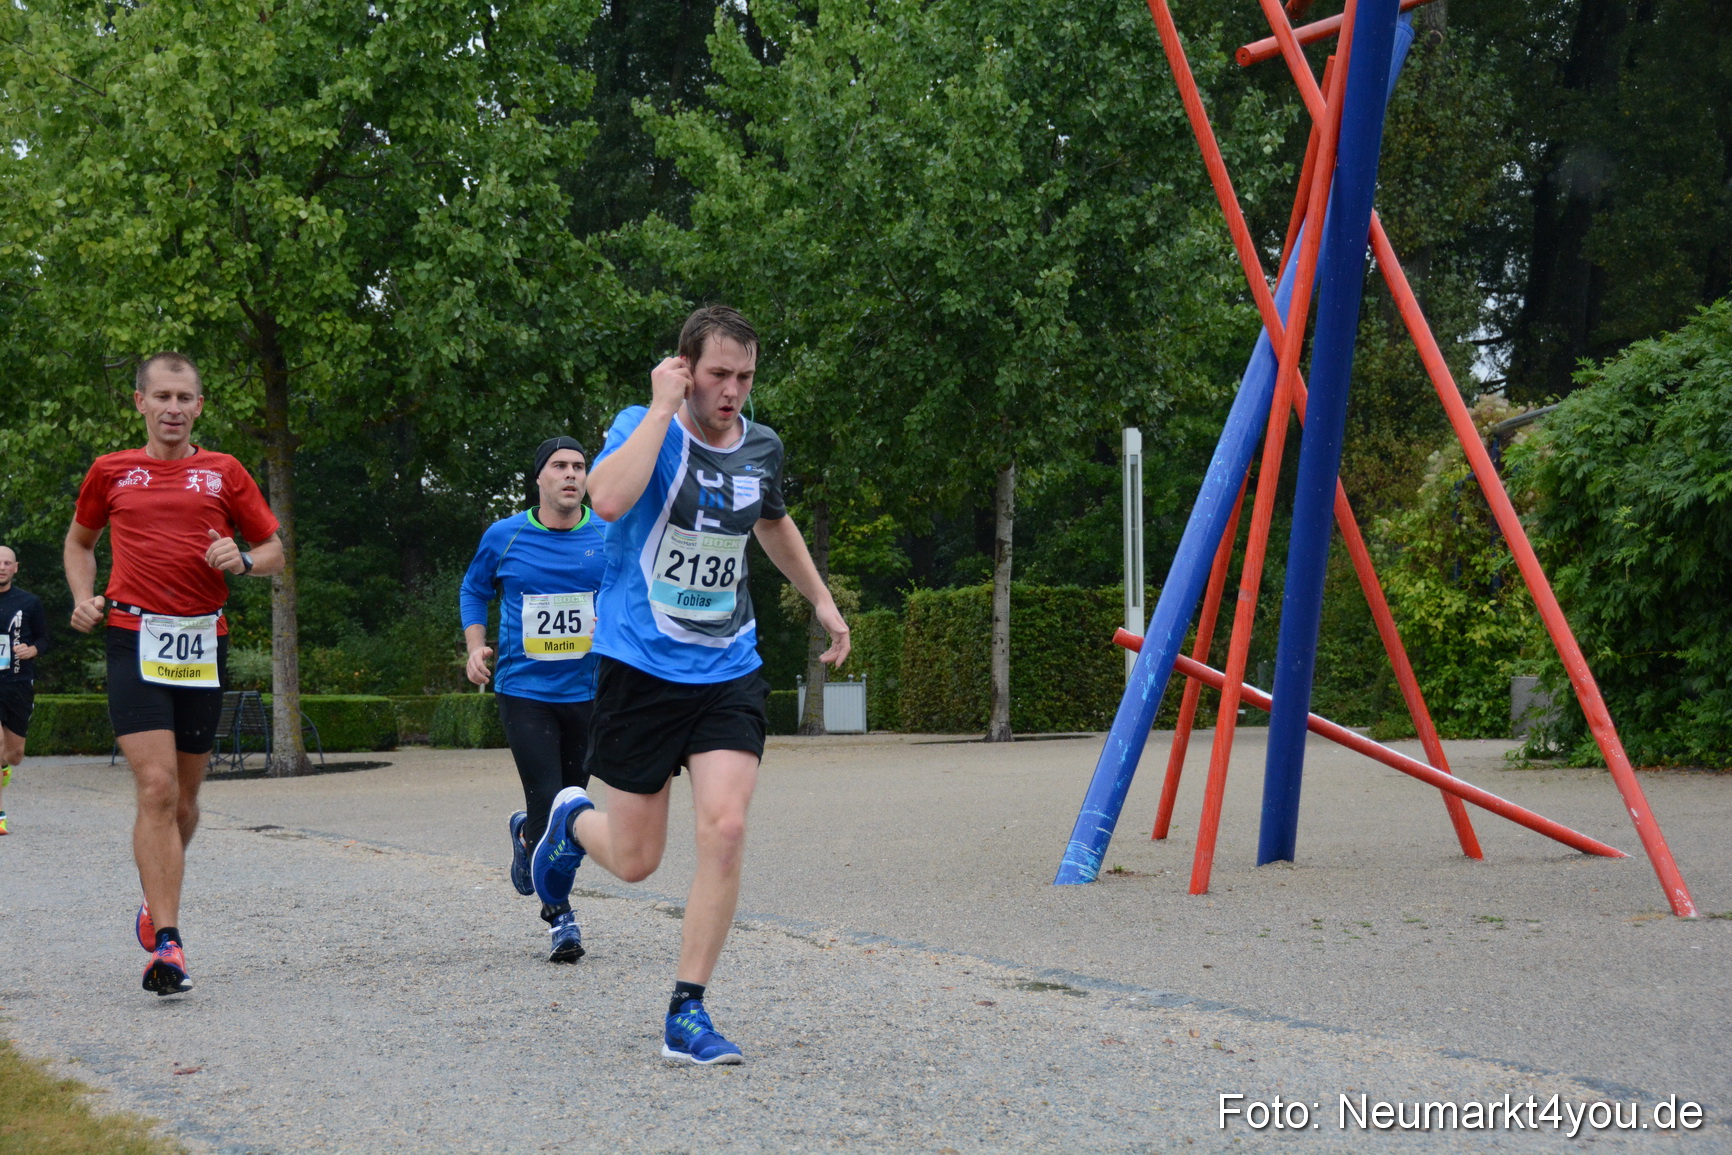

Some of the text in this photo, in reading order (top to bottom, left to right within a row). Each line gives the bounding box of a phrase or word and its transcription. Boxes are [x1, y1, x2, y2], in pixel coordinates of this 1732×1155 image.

[664, 549, 736, 588] 2138
[677, 591, 712, 608] Tobias
[537, 609, 582, 635] 245
[158, 632, 205, 660] 204
[544, 640, 575, 652] Martin
[157, 665, 201, 678] Christian
